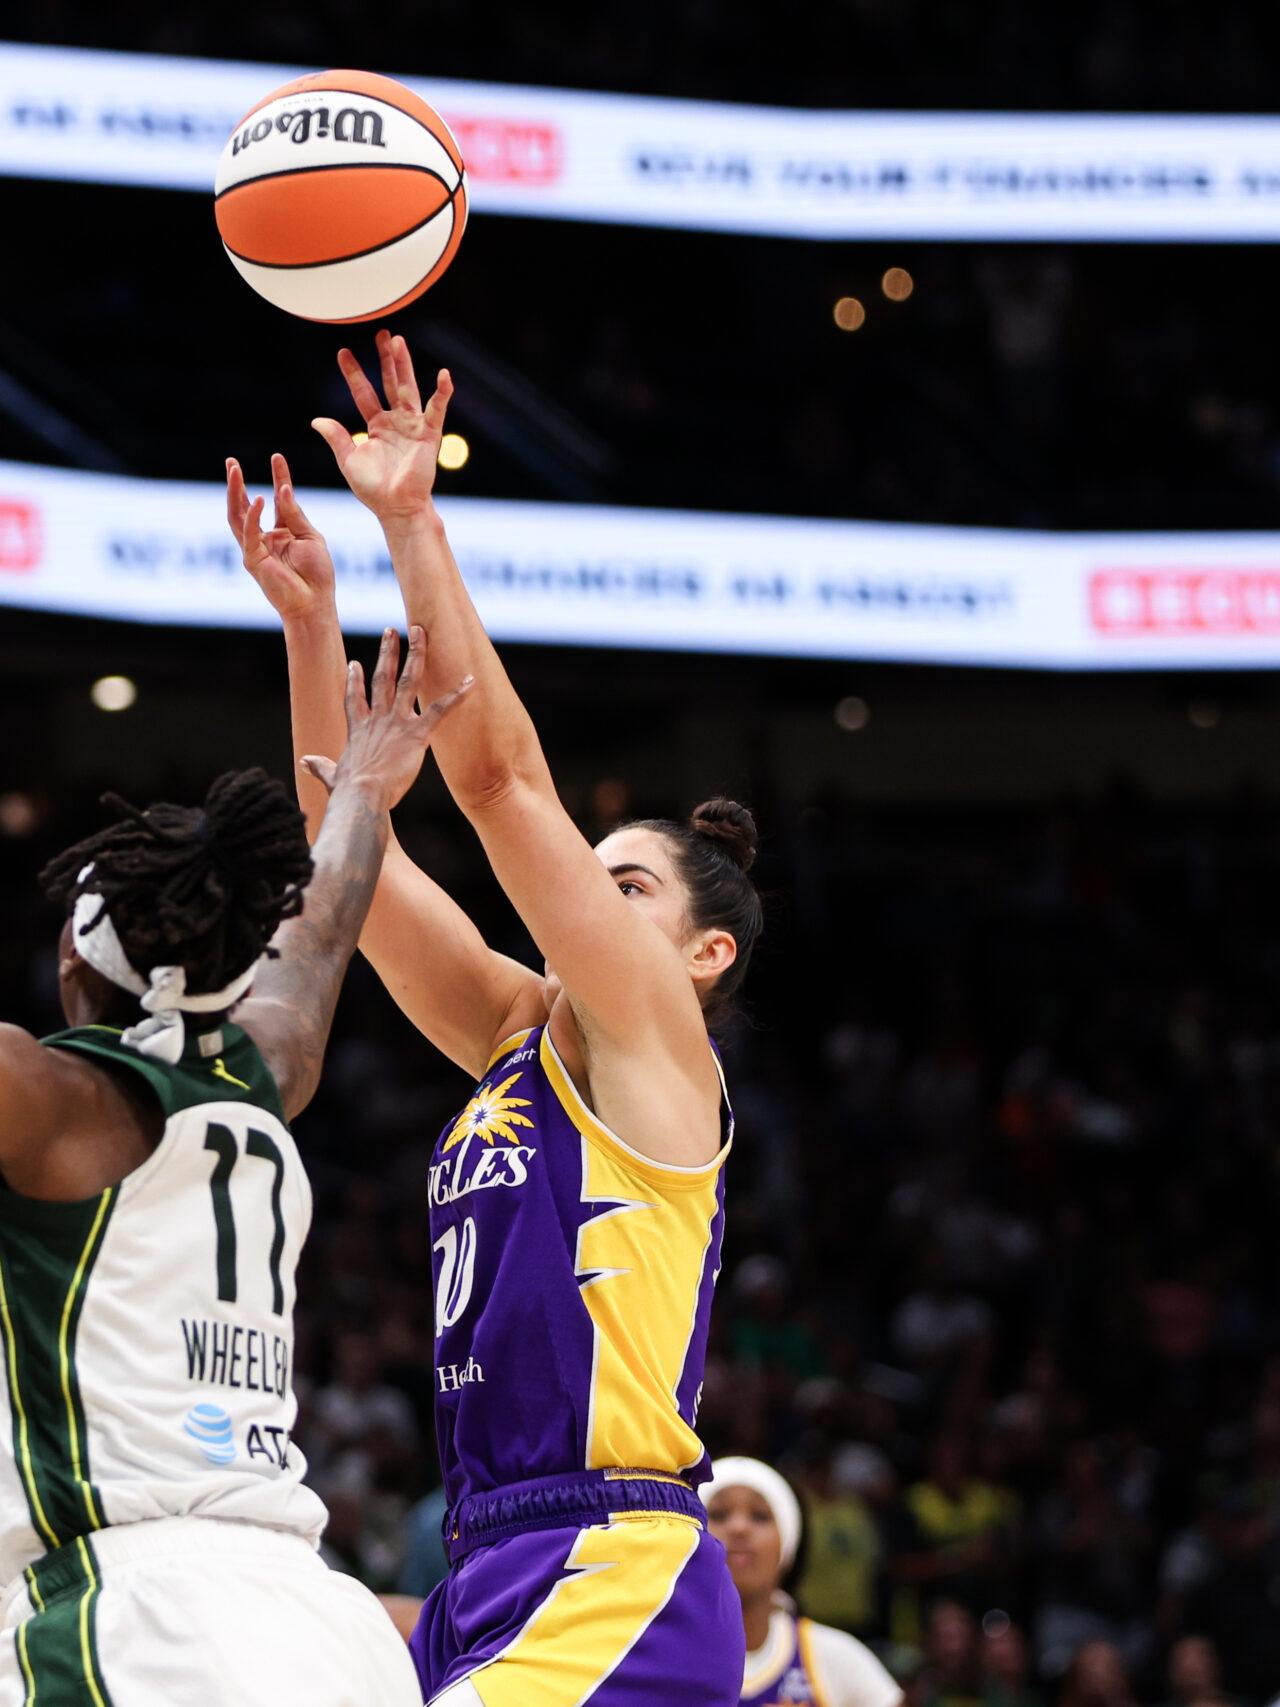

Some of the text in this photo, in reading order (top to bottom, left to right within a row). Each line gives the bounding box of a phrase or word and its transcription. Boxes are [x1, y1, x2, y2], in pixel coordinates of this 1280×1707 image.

[231, 106, 387, 157] Wilson
[203, 1121, 285, 1317] 17
[433, 1216, 477, 1338] 10
